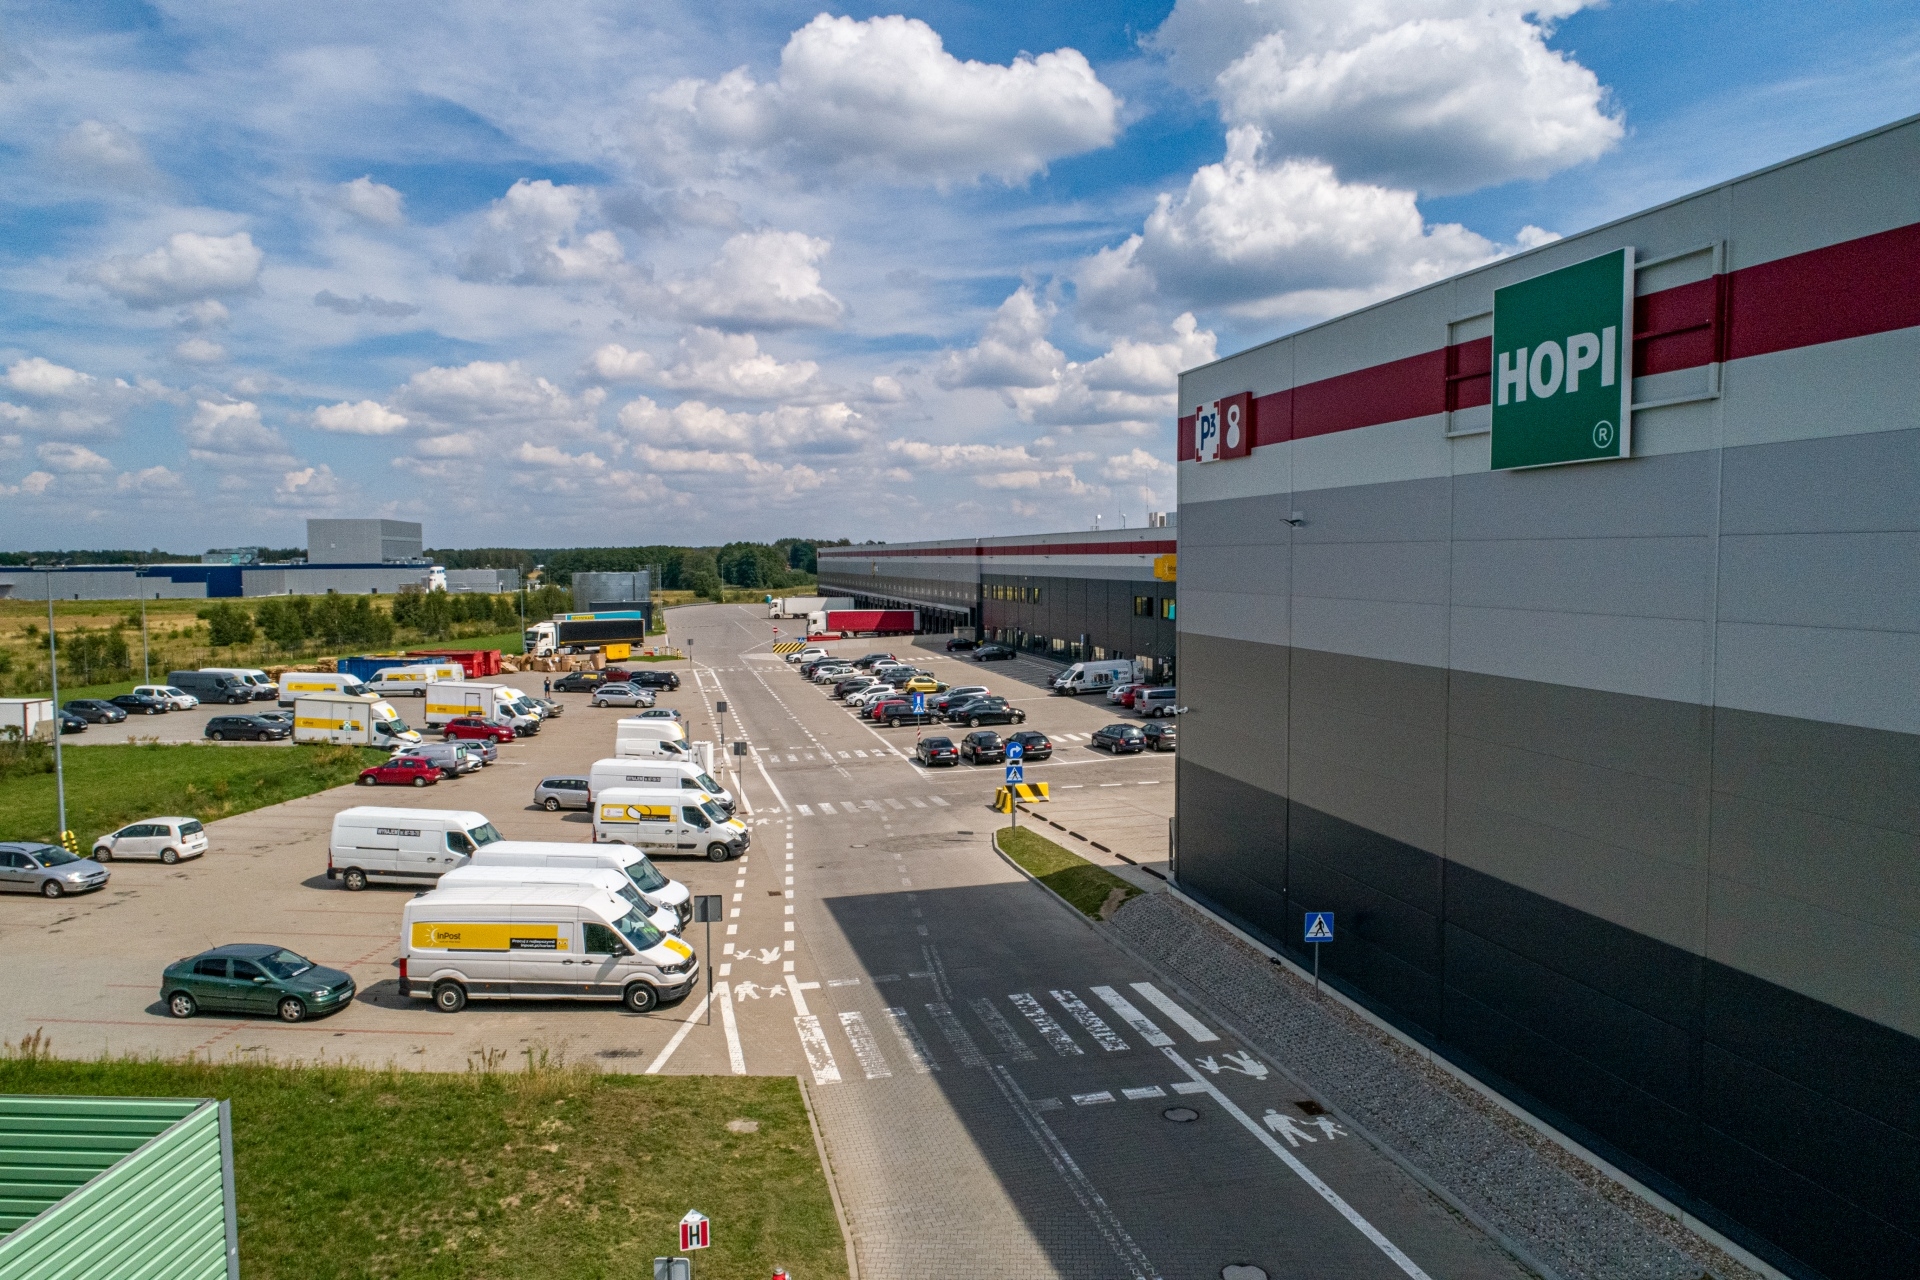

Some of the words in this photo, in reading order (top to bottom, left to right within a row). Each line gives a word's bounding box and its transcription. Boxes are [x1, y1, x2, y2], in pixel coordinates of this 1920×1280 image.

[1498, 325, 1616, 406] HOPI
[1226, 404, 1240, 449] 8
[689, 1224, 701, 1246] H
